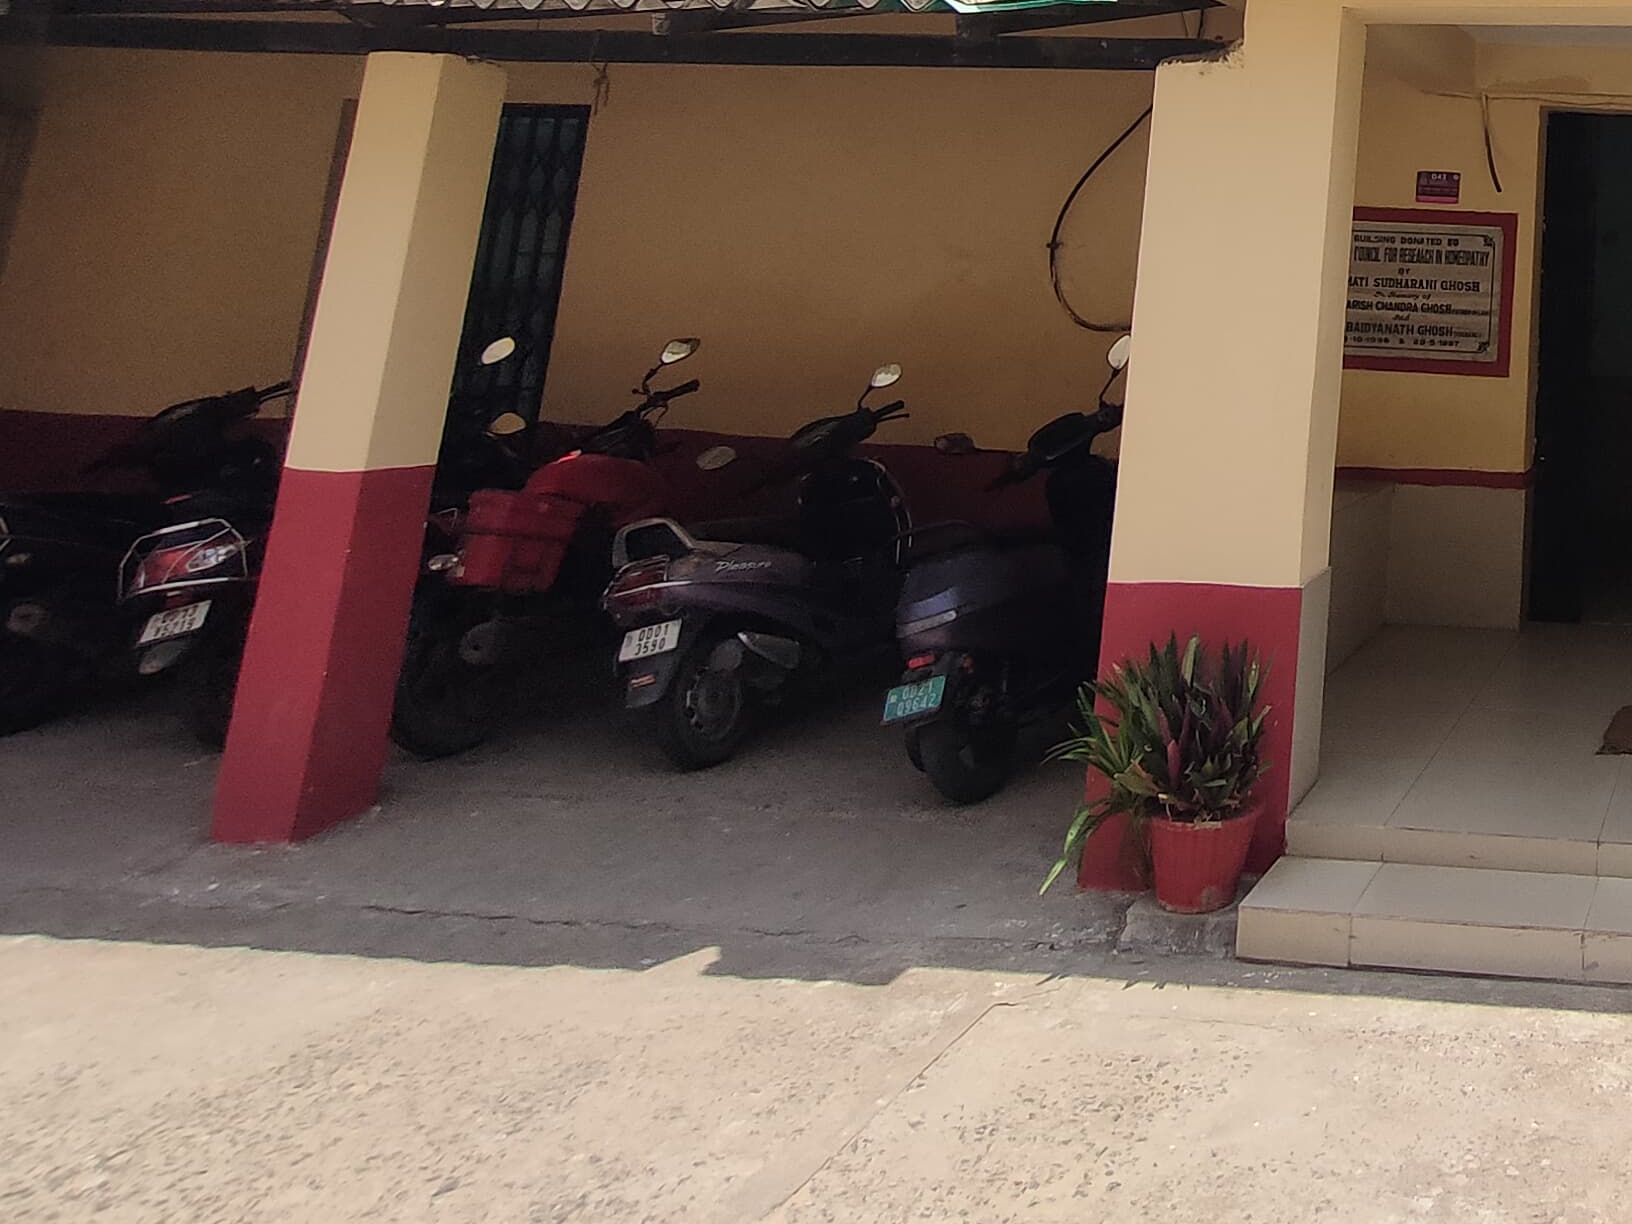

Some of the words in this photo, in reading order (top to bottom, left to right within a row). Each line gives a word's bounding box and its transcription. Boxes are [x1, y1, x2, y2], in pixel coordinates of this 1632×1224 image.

[1440, 279, 1481, 292] GHOSH
[1375, 301, 1418, 313] CHANDRA
[1417, 325, 1453, 337] GHOSH
